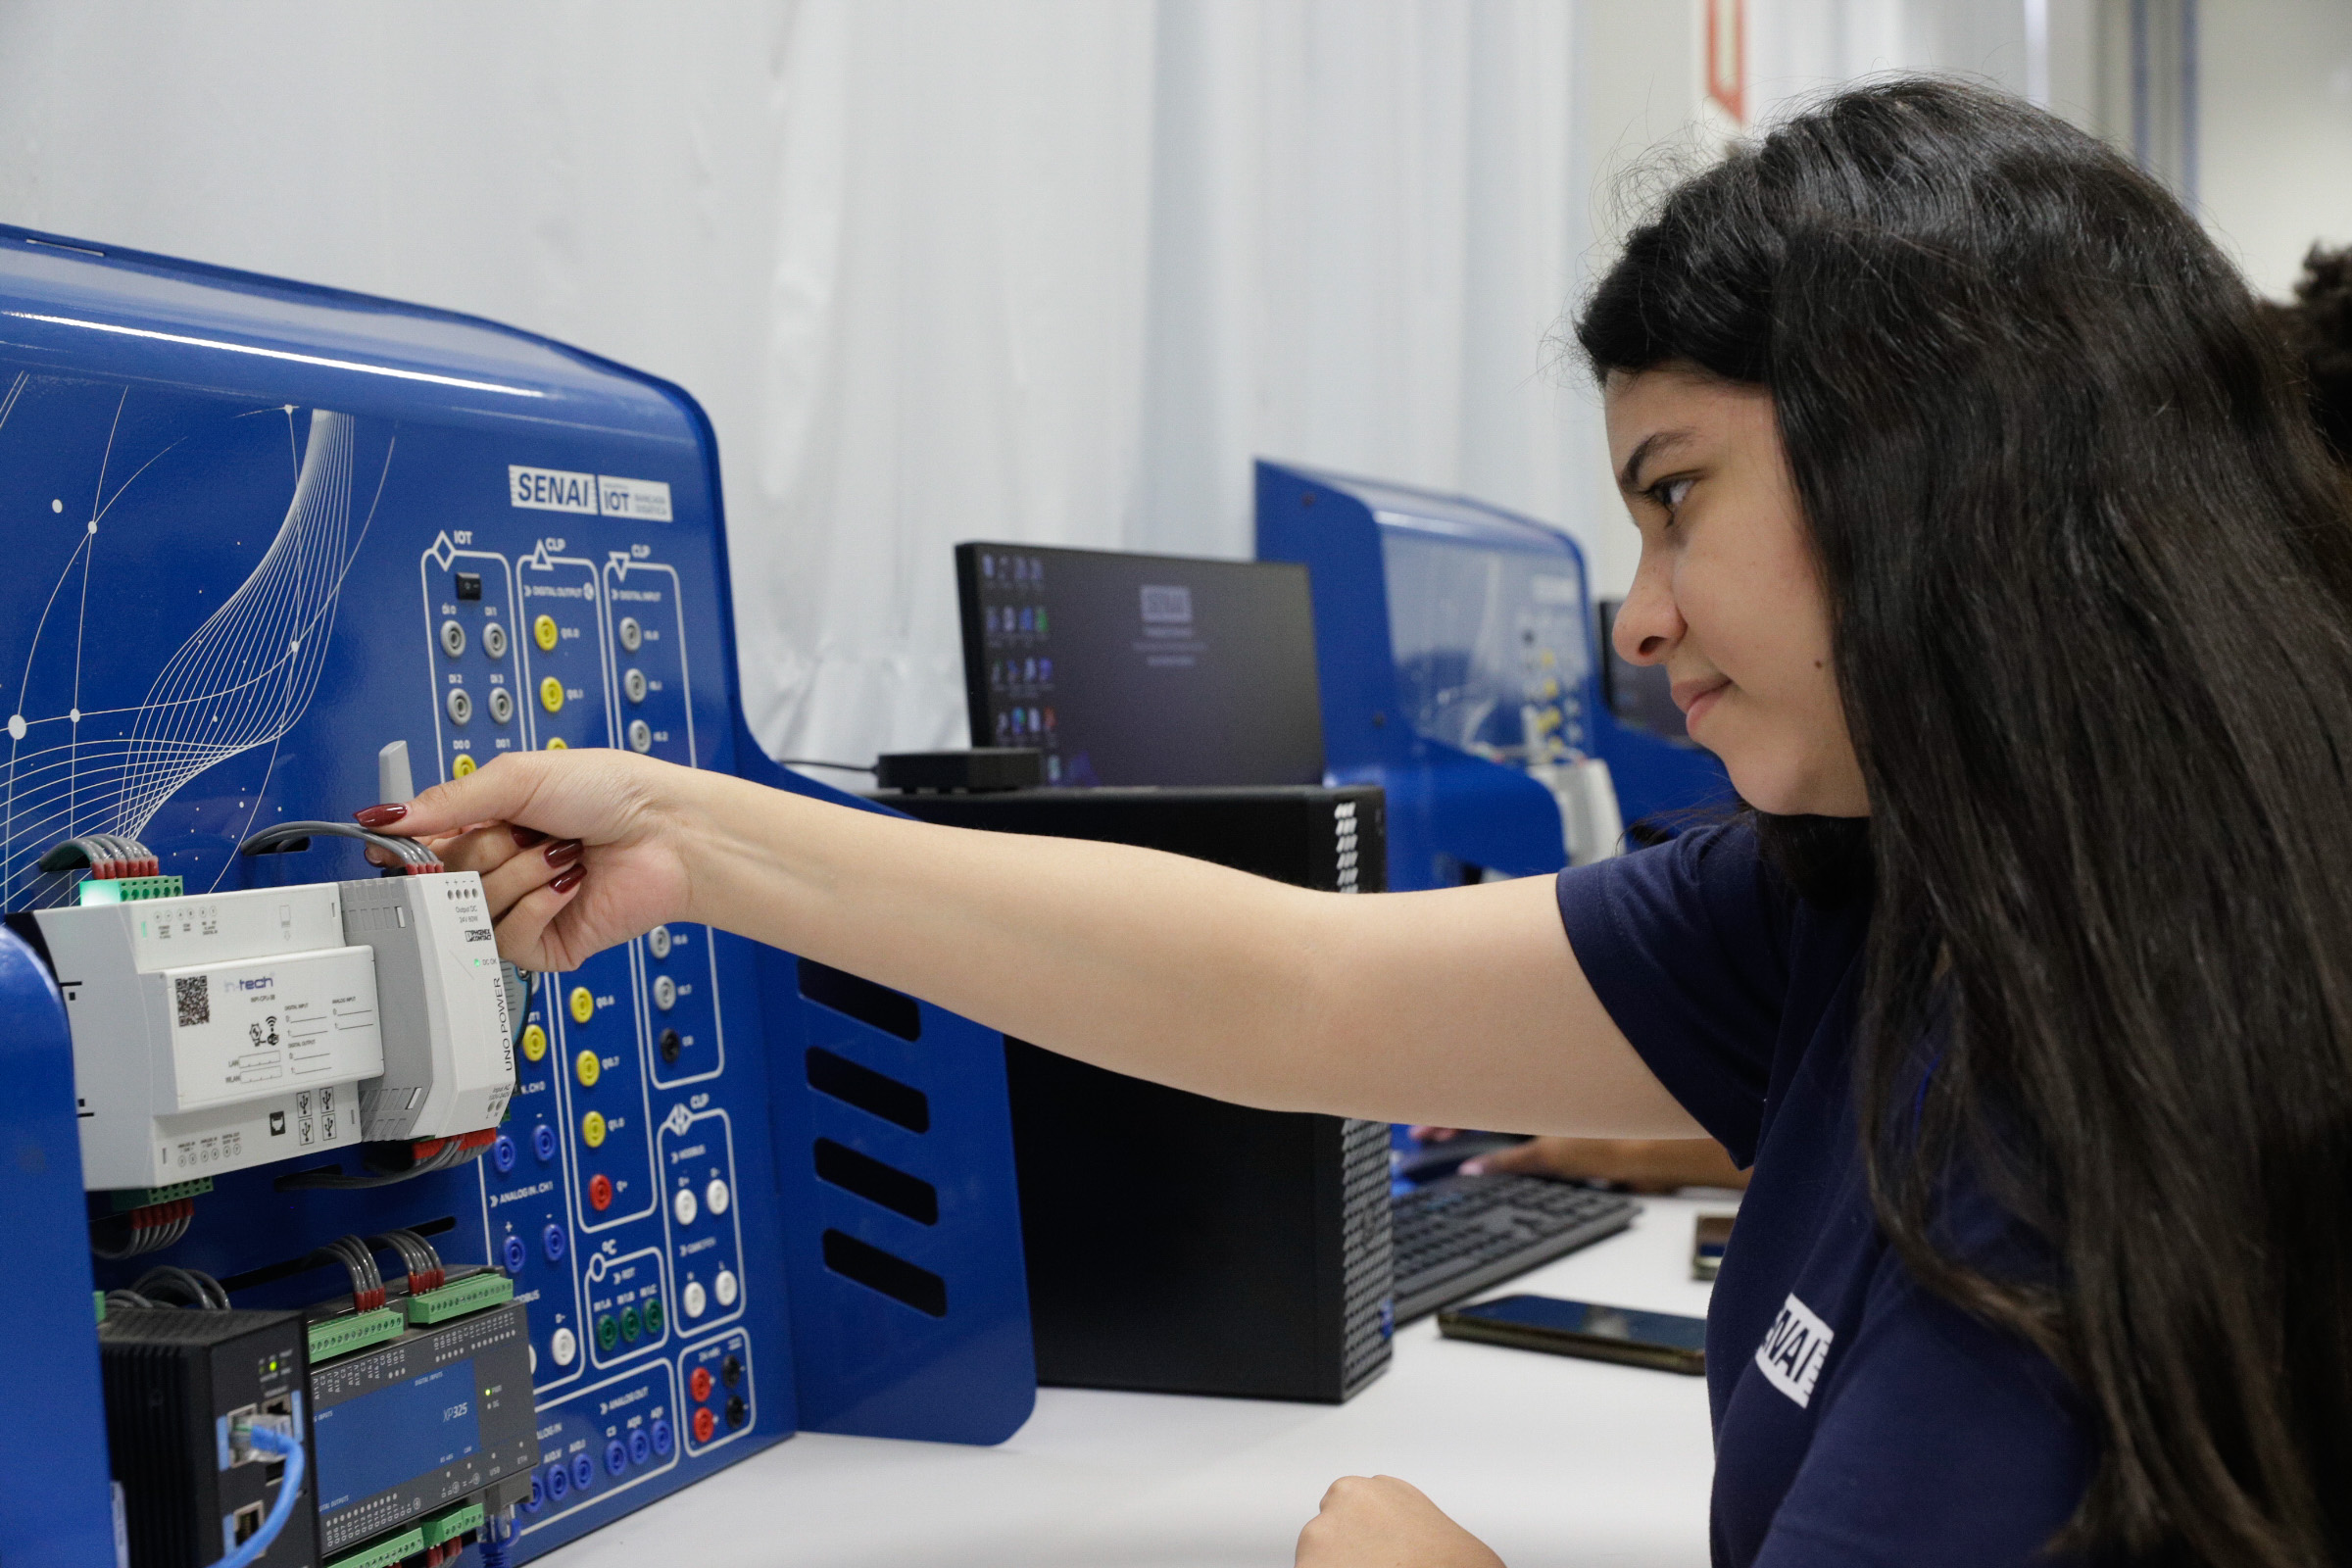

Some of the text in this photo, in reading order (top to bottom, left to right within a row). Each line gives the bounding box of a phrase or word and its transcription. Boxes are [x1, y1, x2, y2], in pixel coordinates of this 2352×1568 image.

[518, 472, 589, 508] SENAI
[604, 491, 629, 512] IOT
[454, 530, 472, 545] IOT
[493, 977, 513, 1072] UNO POWER
[500, 1187, 529, 1203] ANALOG
[1763, 1309, 1821, 1384] NAI
[443, 1401, 467, 1423] XP325
